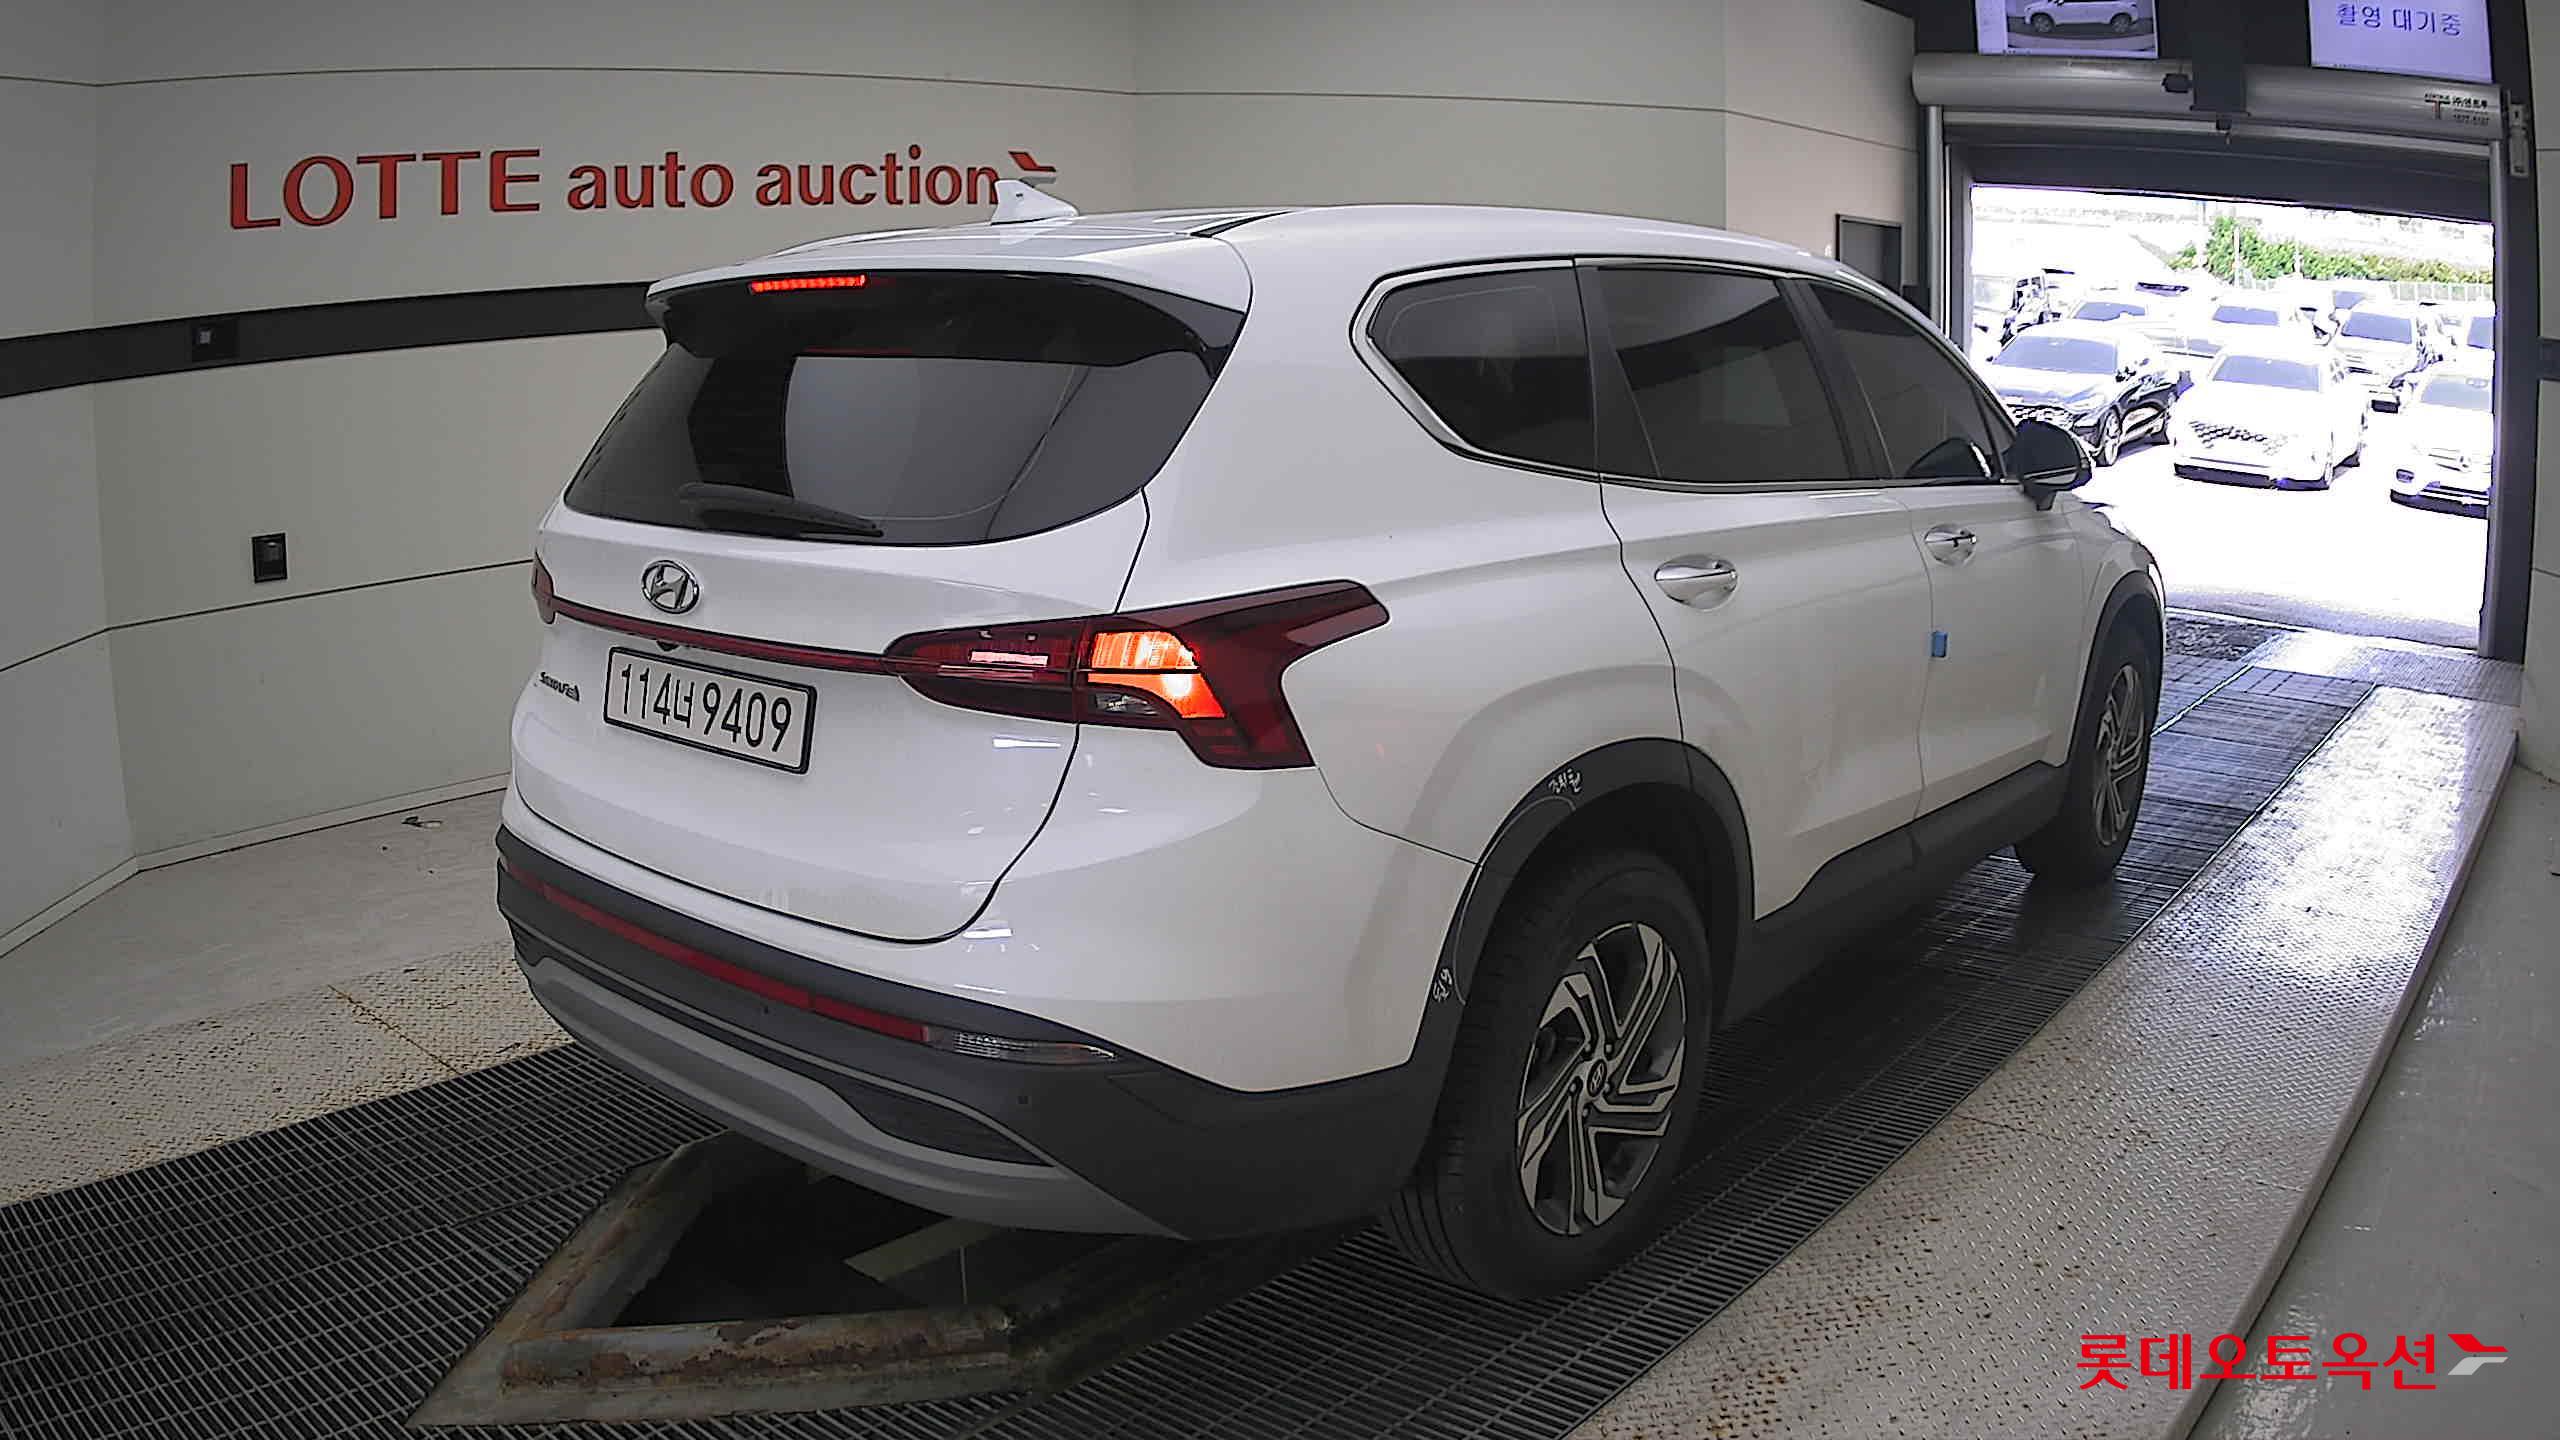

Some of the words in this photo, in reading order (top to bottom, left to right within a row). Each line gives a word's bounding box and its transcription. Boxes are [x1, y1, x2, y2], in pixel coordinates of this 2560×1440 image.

[2337, 3, 2381, 29] 촬영
[2392, 8, 2461, 36] 대기중
[230, 150, 539, 229] LOTTE
[566, 153, 734, 209] auto
[756, 146, 999, 206] auction
